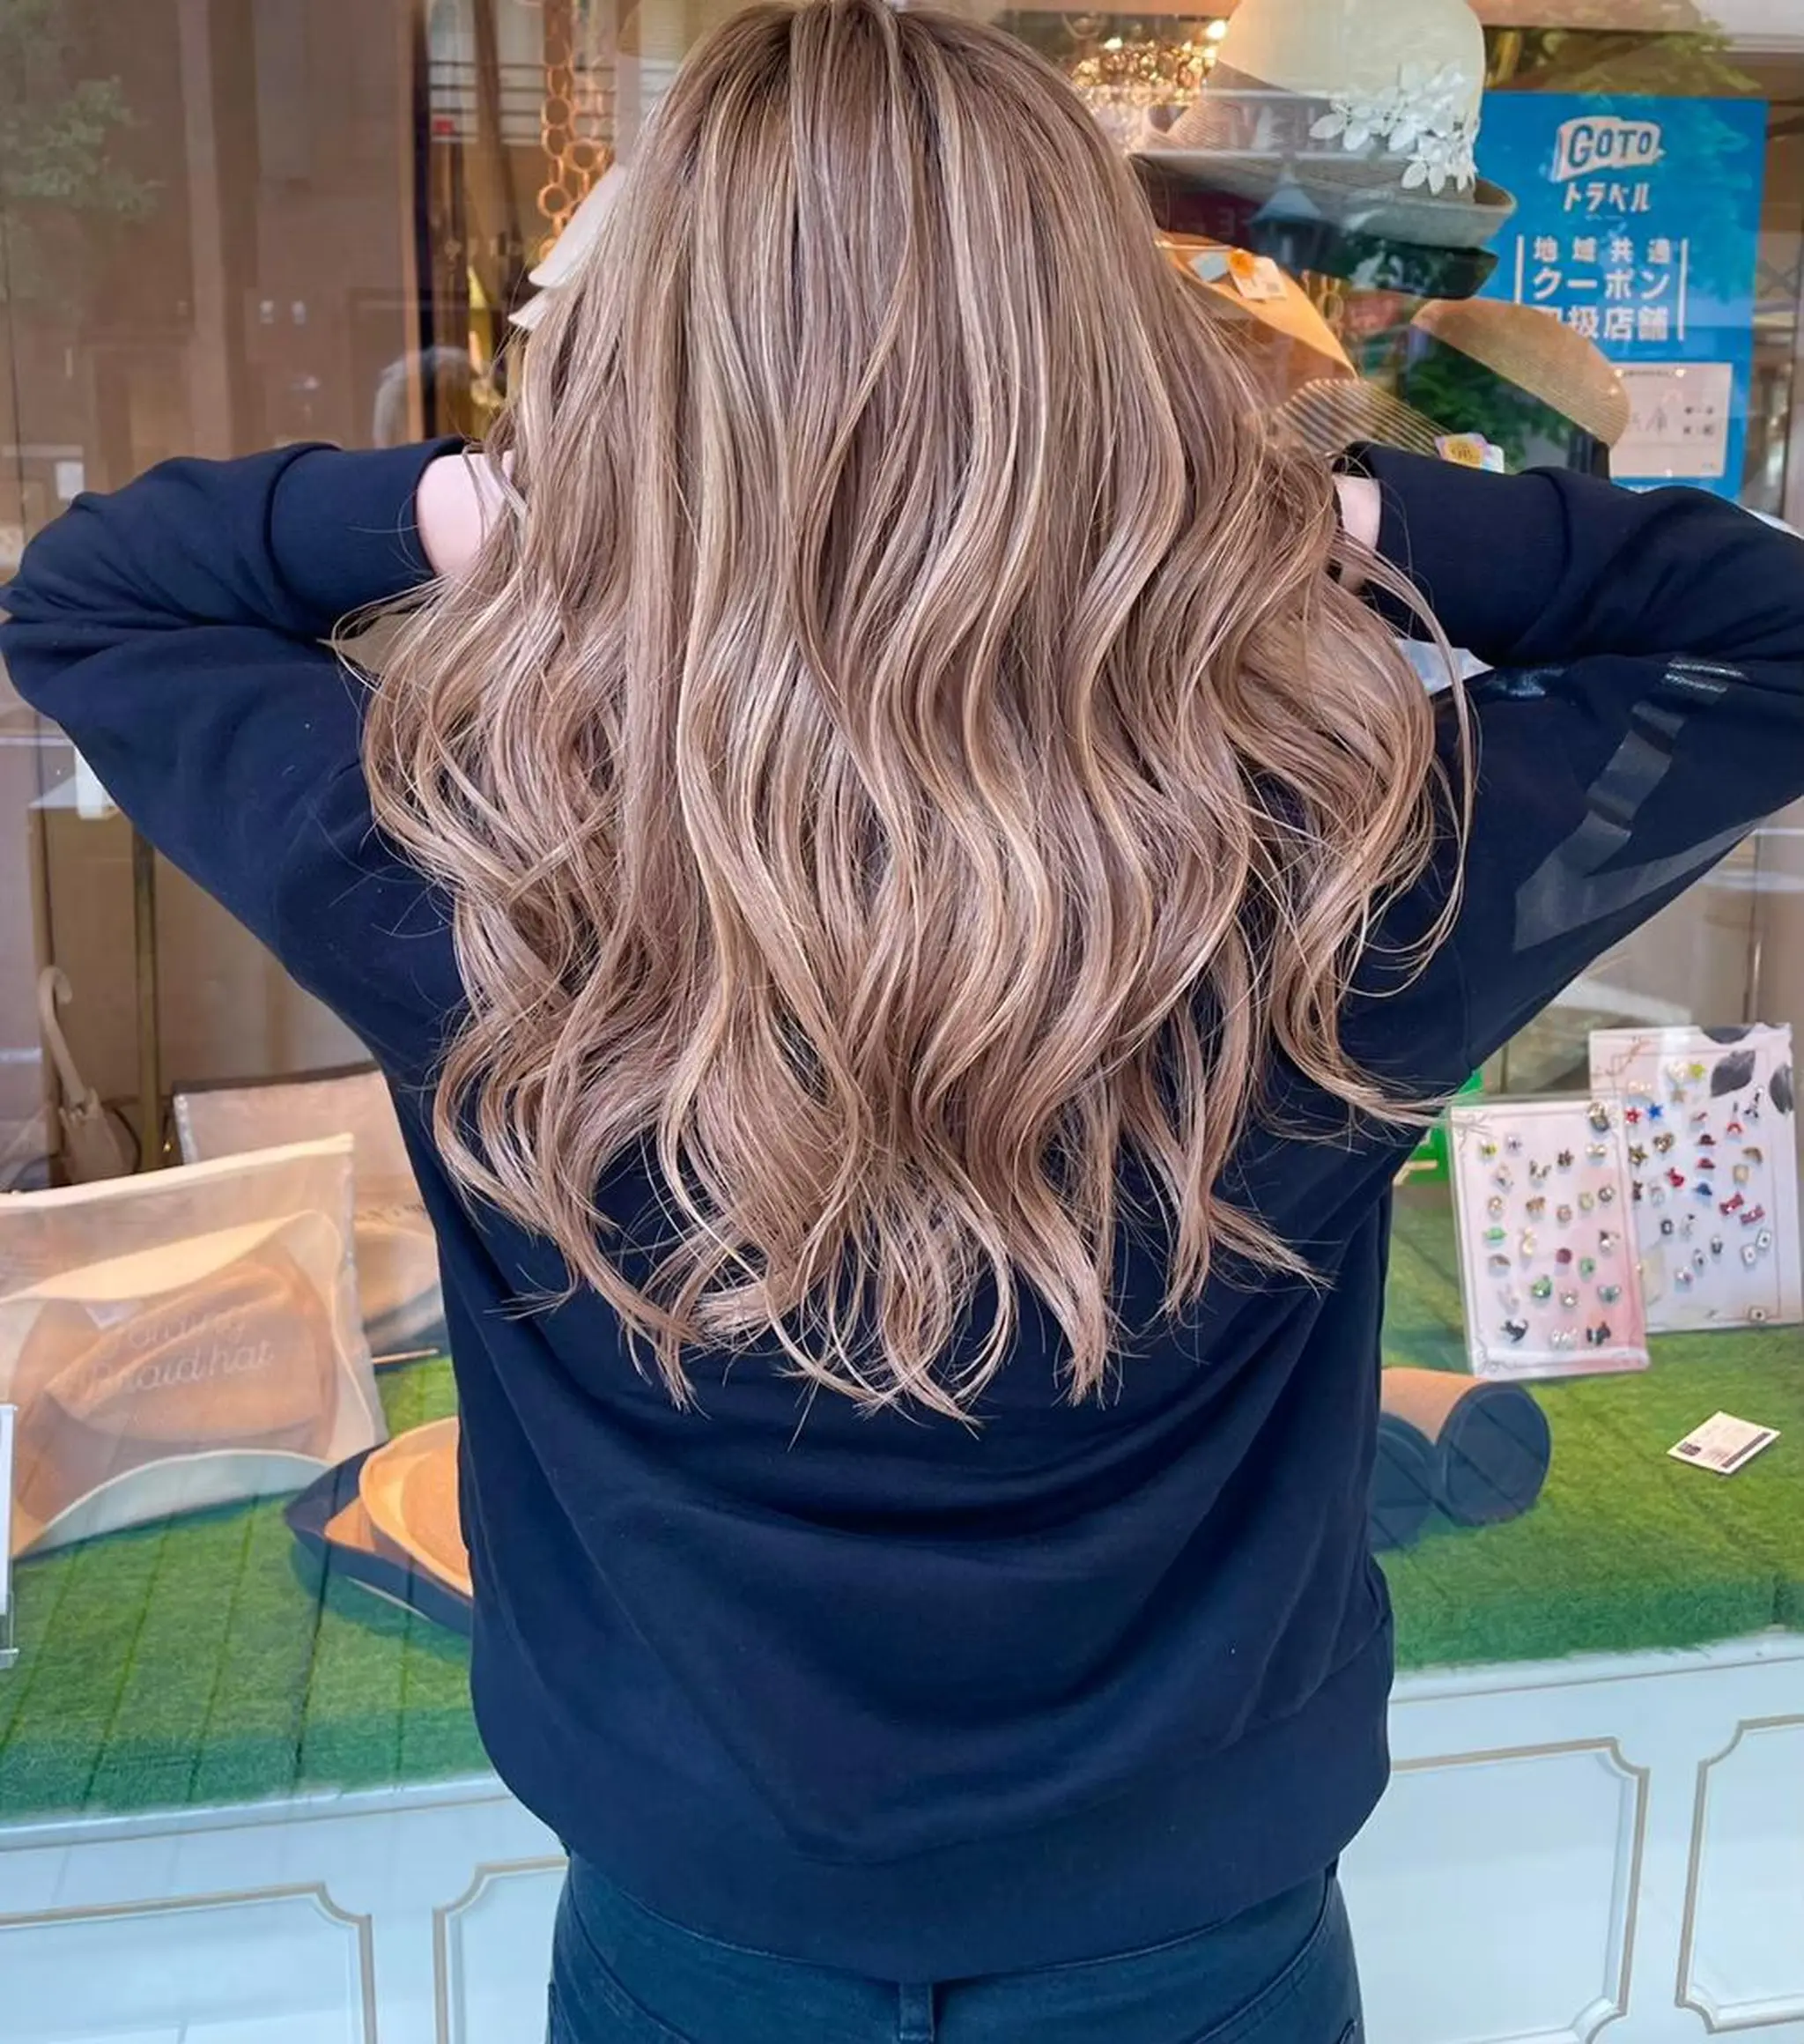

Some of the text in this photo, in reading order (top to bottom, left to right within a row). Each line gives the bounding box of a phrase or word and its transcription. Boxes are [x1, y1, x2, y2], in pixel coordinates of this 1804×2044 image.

[1564, 181, 1650, 211] トラベル
[1534, 236, 1671, 263] 地域共通
[1534, 267, 1671, 300] クーポン
